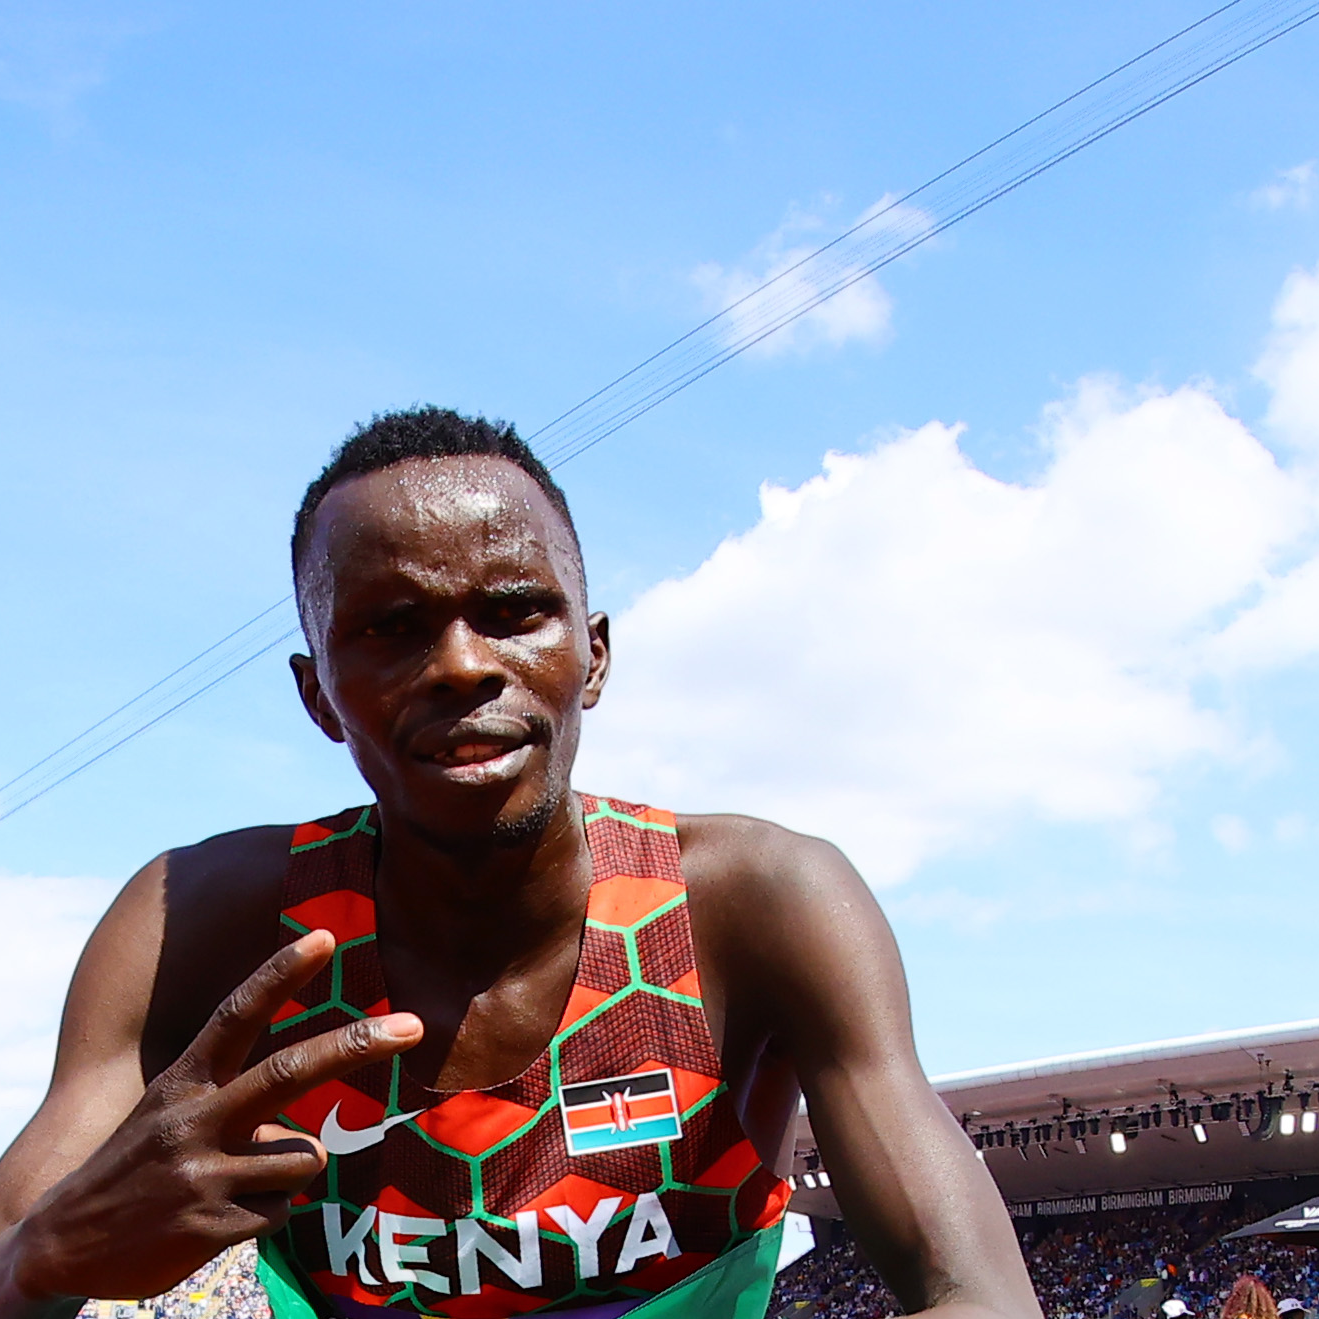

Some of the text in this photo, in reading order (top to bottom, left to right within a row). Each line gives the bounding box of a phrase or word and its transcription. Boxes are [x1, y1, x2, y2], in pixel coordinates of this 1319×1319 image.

[1037, 1197, 1097, 1216] BIRMINGHAM
[1101, 1191, 1164, 1211] BIRMINGHAM
[1168, 1185, 1233, 1205] BIRMINGHAM
[322, 1191, 682, 1295] KENYA
